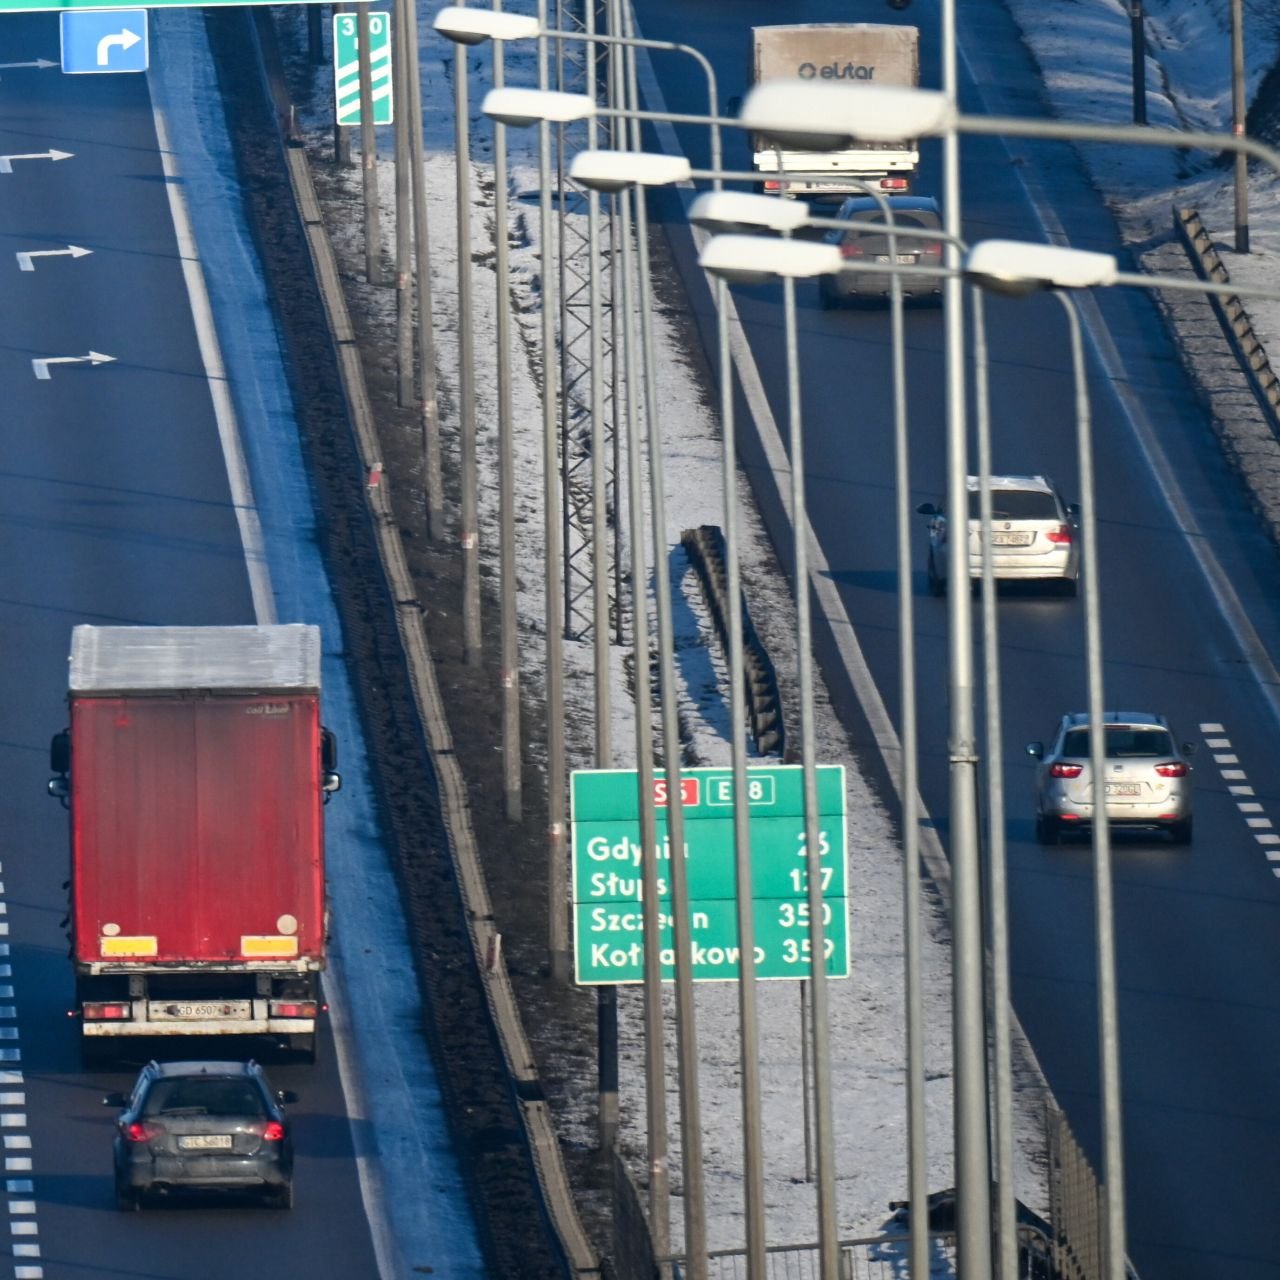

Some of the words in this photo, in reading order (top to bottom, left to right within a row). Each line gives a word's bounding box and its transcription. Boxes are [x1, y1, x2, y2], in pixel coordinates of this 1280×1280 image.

[341, 17, 382, 36] 30
[820, 62, 874, 80] elstar
[718, 781, 763, 800] E8
[586, 835, 689, 867] Gdyi
[589, 872, 669, 902] Słus
[590, 907, 709, 932] Szczen
[591, 941, 766, 967] Kołakowo
[179, 1005, 192, 1015] GD
